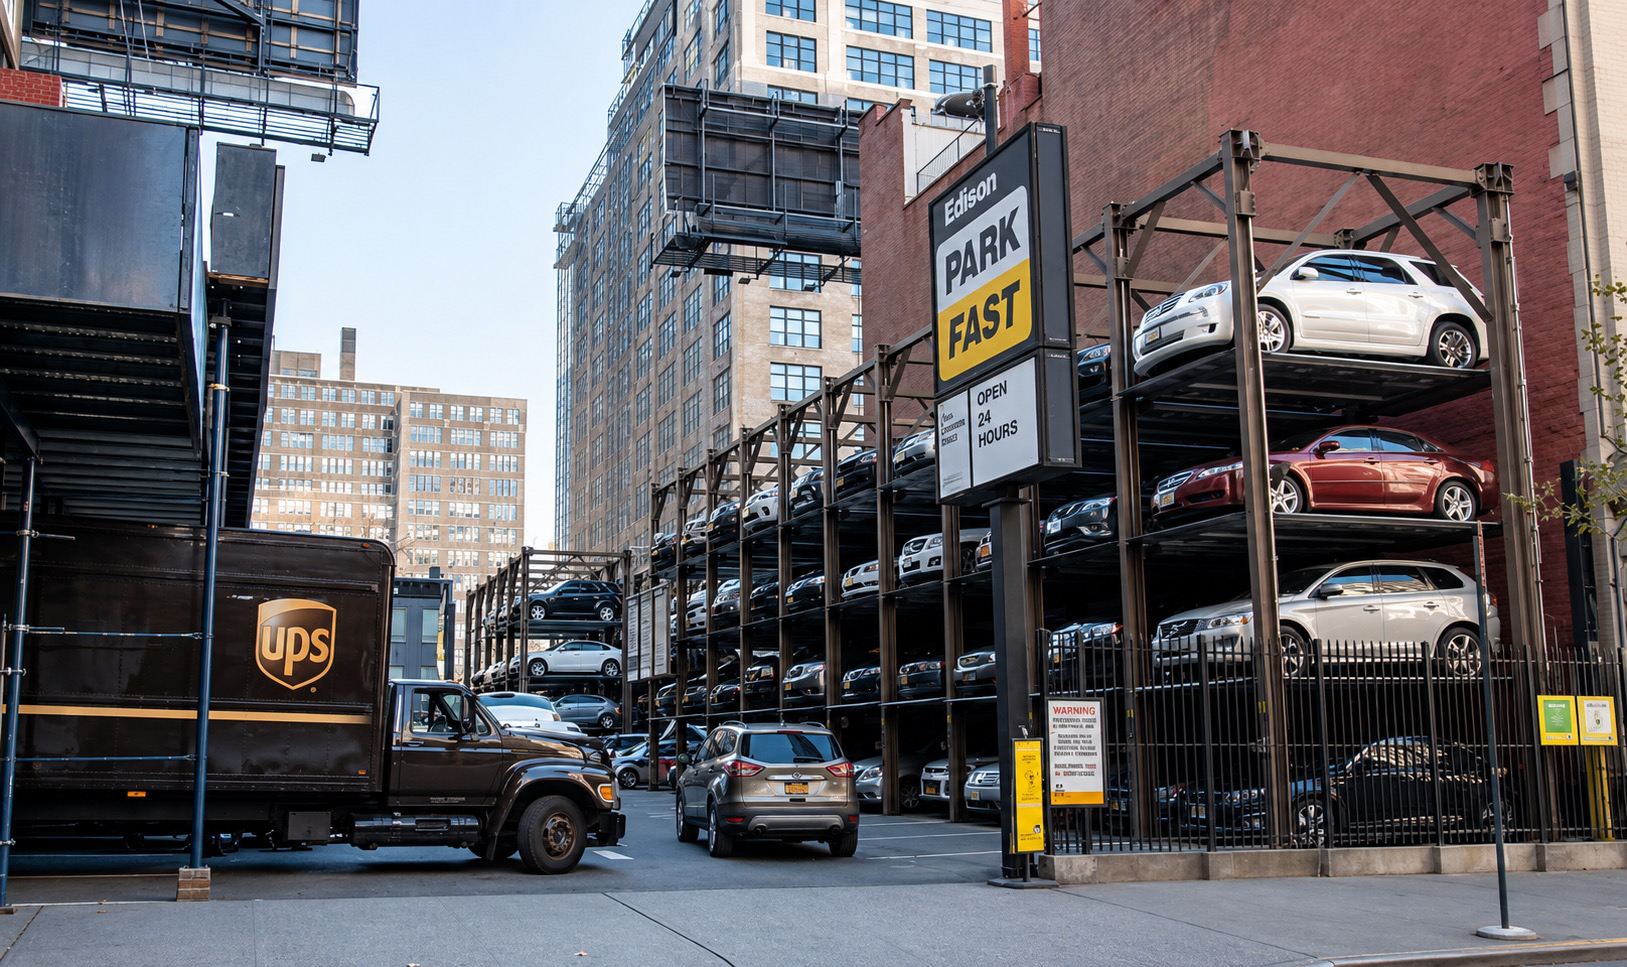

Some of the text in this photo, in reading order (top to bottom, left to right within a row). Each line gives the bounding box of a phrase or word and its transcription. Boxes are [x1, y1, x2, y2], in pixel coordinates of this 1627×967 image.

[945, 172, 997, 227] Edison
[945, 206, 1021, 296] PARK
[949, 280, 1021, 360] FAST
[977, 380, 1008, 407] OPEN
[978, 409, 992, 428] 24
[978, 420, 1018, 448] HOURS
[261, 626, 329, 676] ups
[1053, 706, 1096, 716] WARNING
